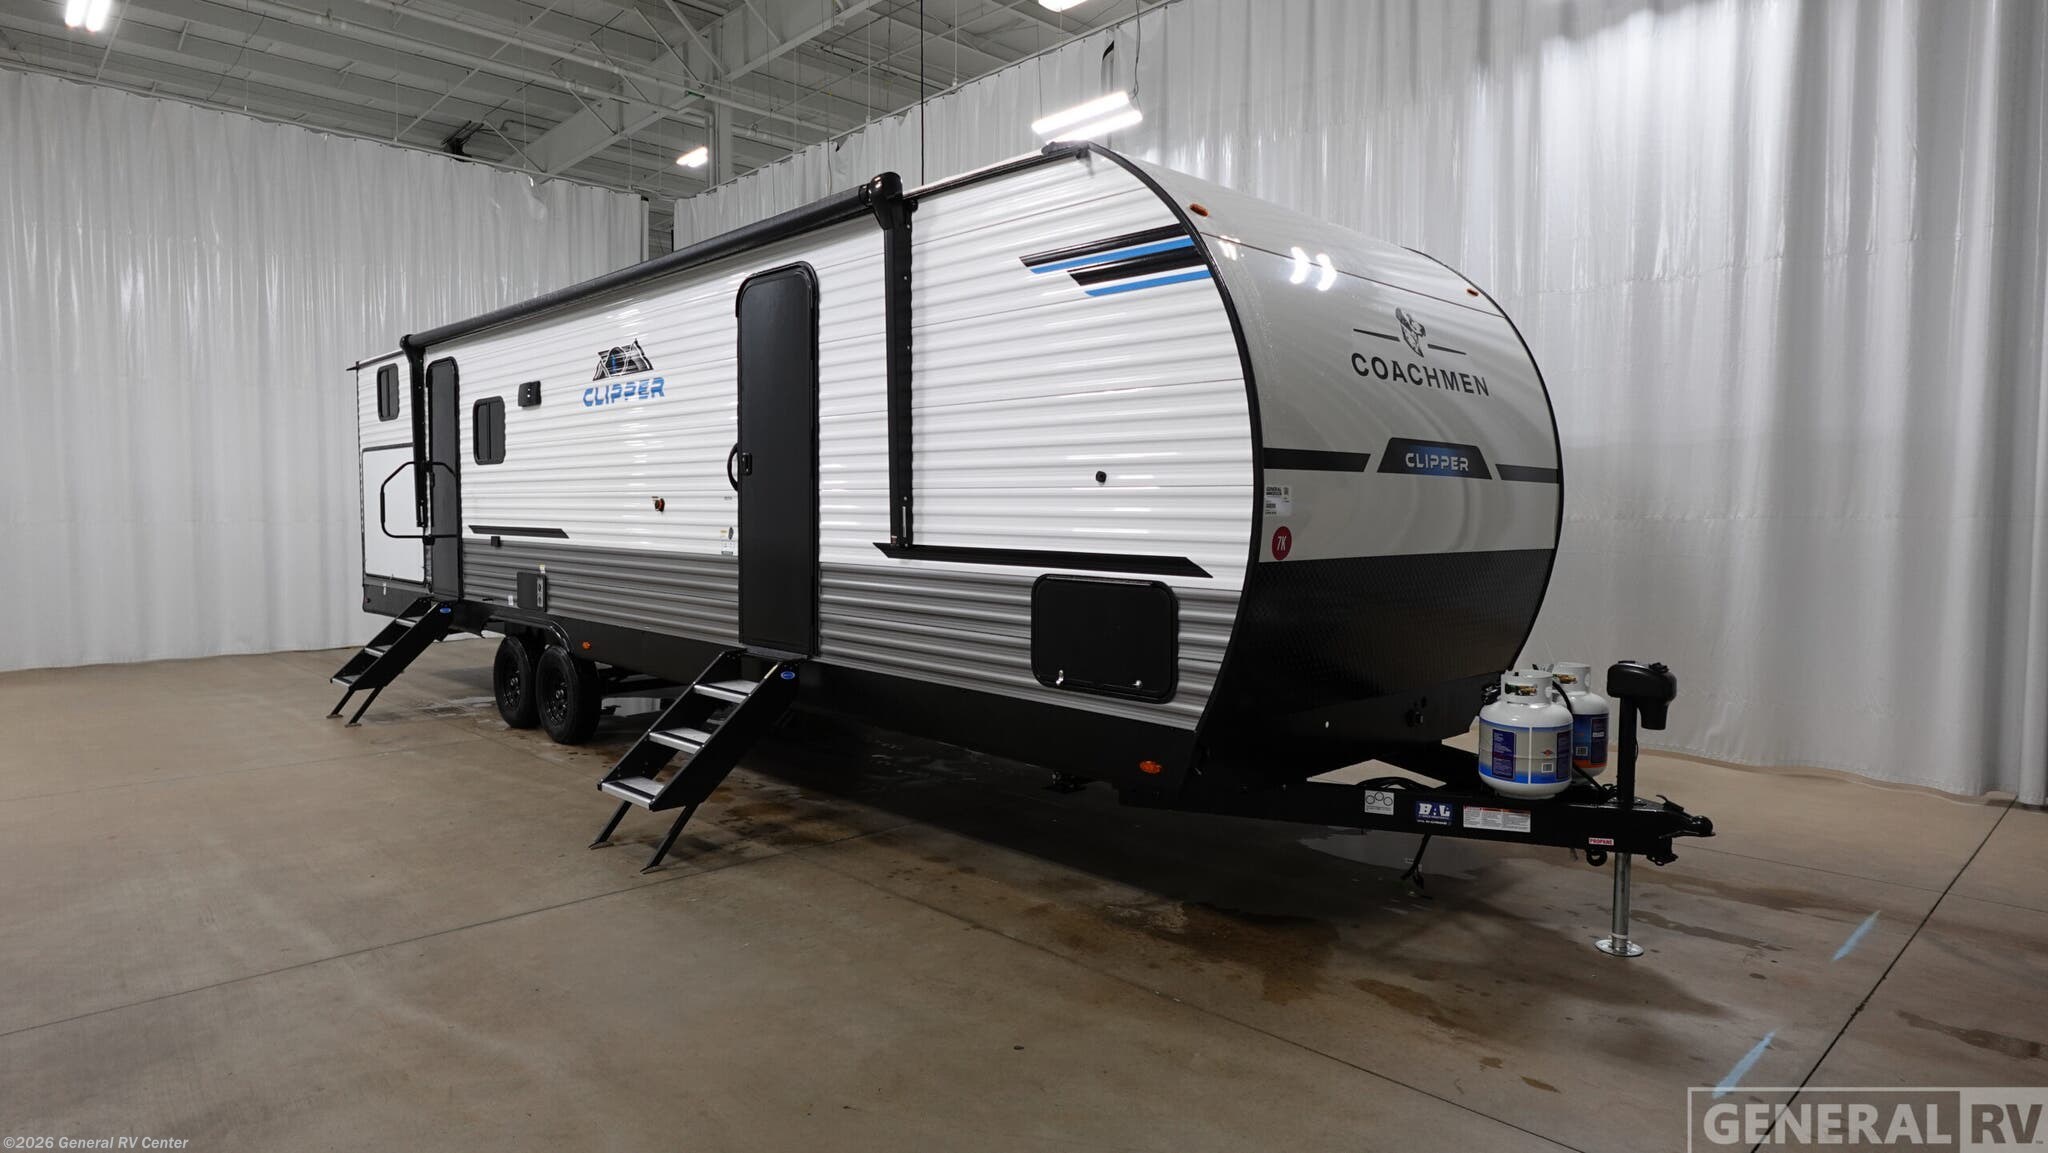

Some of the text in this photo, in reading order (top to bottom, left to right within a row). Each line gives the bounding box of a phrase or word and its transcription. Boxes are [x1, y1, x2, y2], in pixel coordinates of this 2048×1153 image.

[1351, 352, 1489, 396] COACHMEN
[583, 376, 665, 407] CLIPPER
[1405, 452, 1469, 471] CLIPPER
